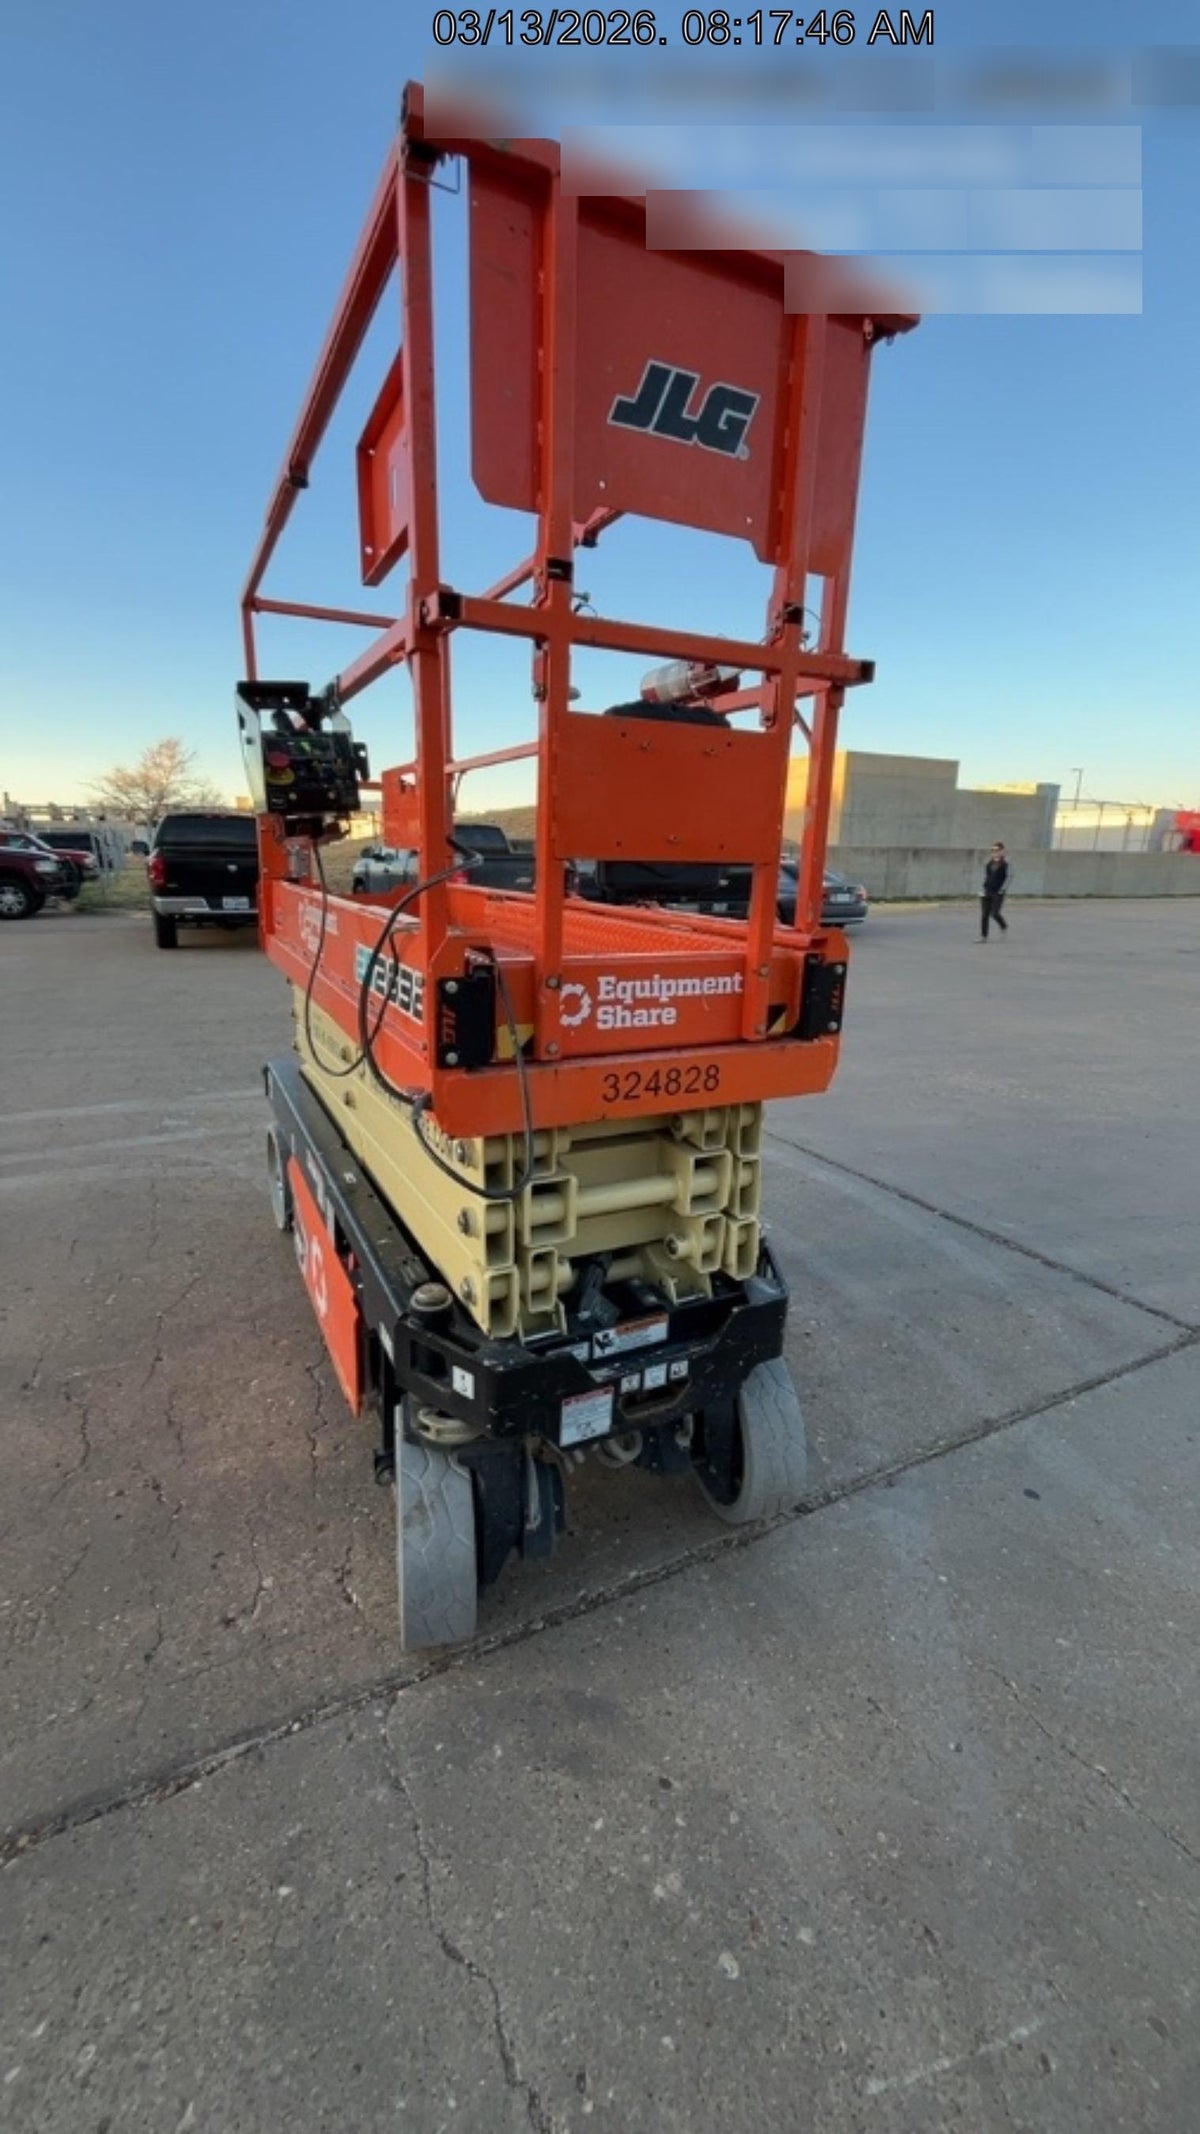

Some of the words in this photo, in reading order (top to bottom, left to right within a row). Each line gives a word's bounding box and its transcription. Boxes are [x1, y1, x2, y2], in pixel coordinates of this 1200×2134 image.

[607, 359, 760, 458] JLG
[597, 971, 743, 1004] Equipment
[597, 1004, 677, 1030] Share
[602, 1064, 720, 1103] 324828
